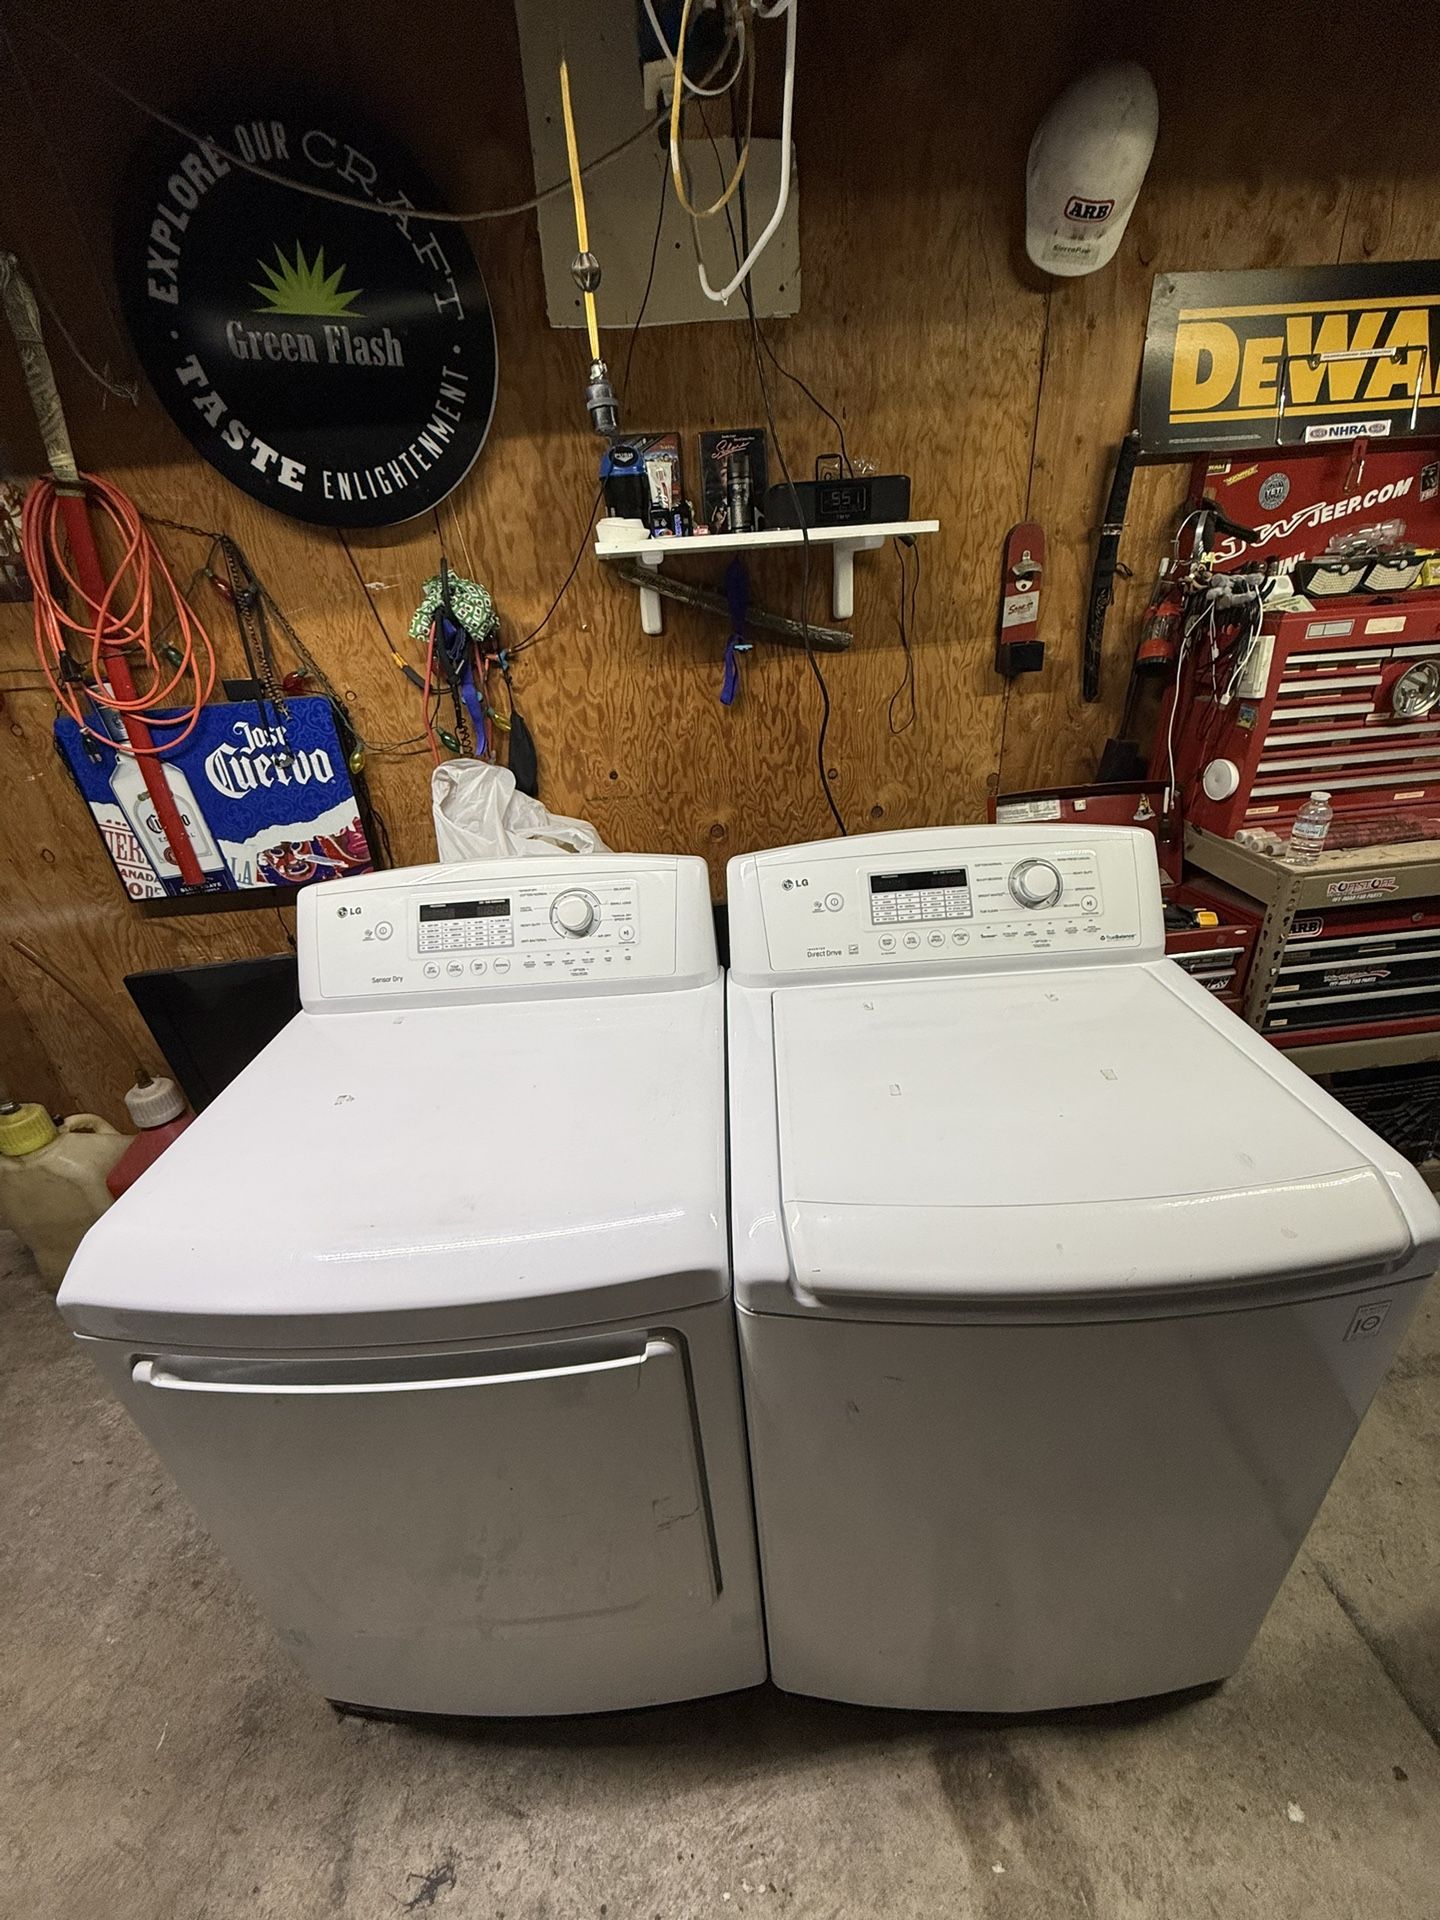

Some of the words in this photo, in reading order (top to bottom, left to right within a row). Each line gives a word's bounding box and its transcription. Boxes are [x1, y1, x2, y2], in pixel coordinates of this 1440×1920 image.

[1068, 201, 1110, 219] ARB
[147, 134, 232, 305] EXPLORE
[234, 120, 290, 164] OUR
[302, 129, 464, 321] CRAFT
[225, 319, 319, 364] Green
[322, 324, 405, 368] Flash
[1169, 308, 1440, 412] DEWA
[174, 353, 307, 493] TASTE
[322, 365, 469, 501] ENLIGHTENMENT
[1328, 423, 1368, 438] NHRA
[1265, 486, 1284, 496] YETI
[1307, 476, 1414, 528] JEEP.COM
[204, 742, 335, 800] Cuervo
[795, 878, 809, 888] LG
[349, 906, 362, 916] LG
[807, 950, 826, 958] Direct
[826, 949, 842, 957] Drive
[371, 976, 392, 984] Sensor
[392, 975, 403, 984] Dry
